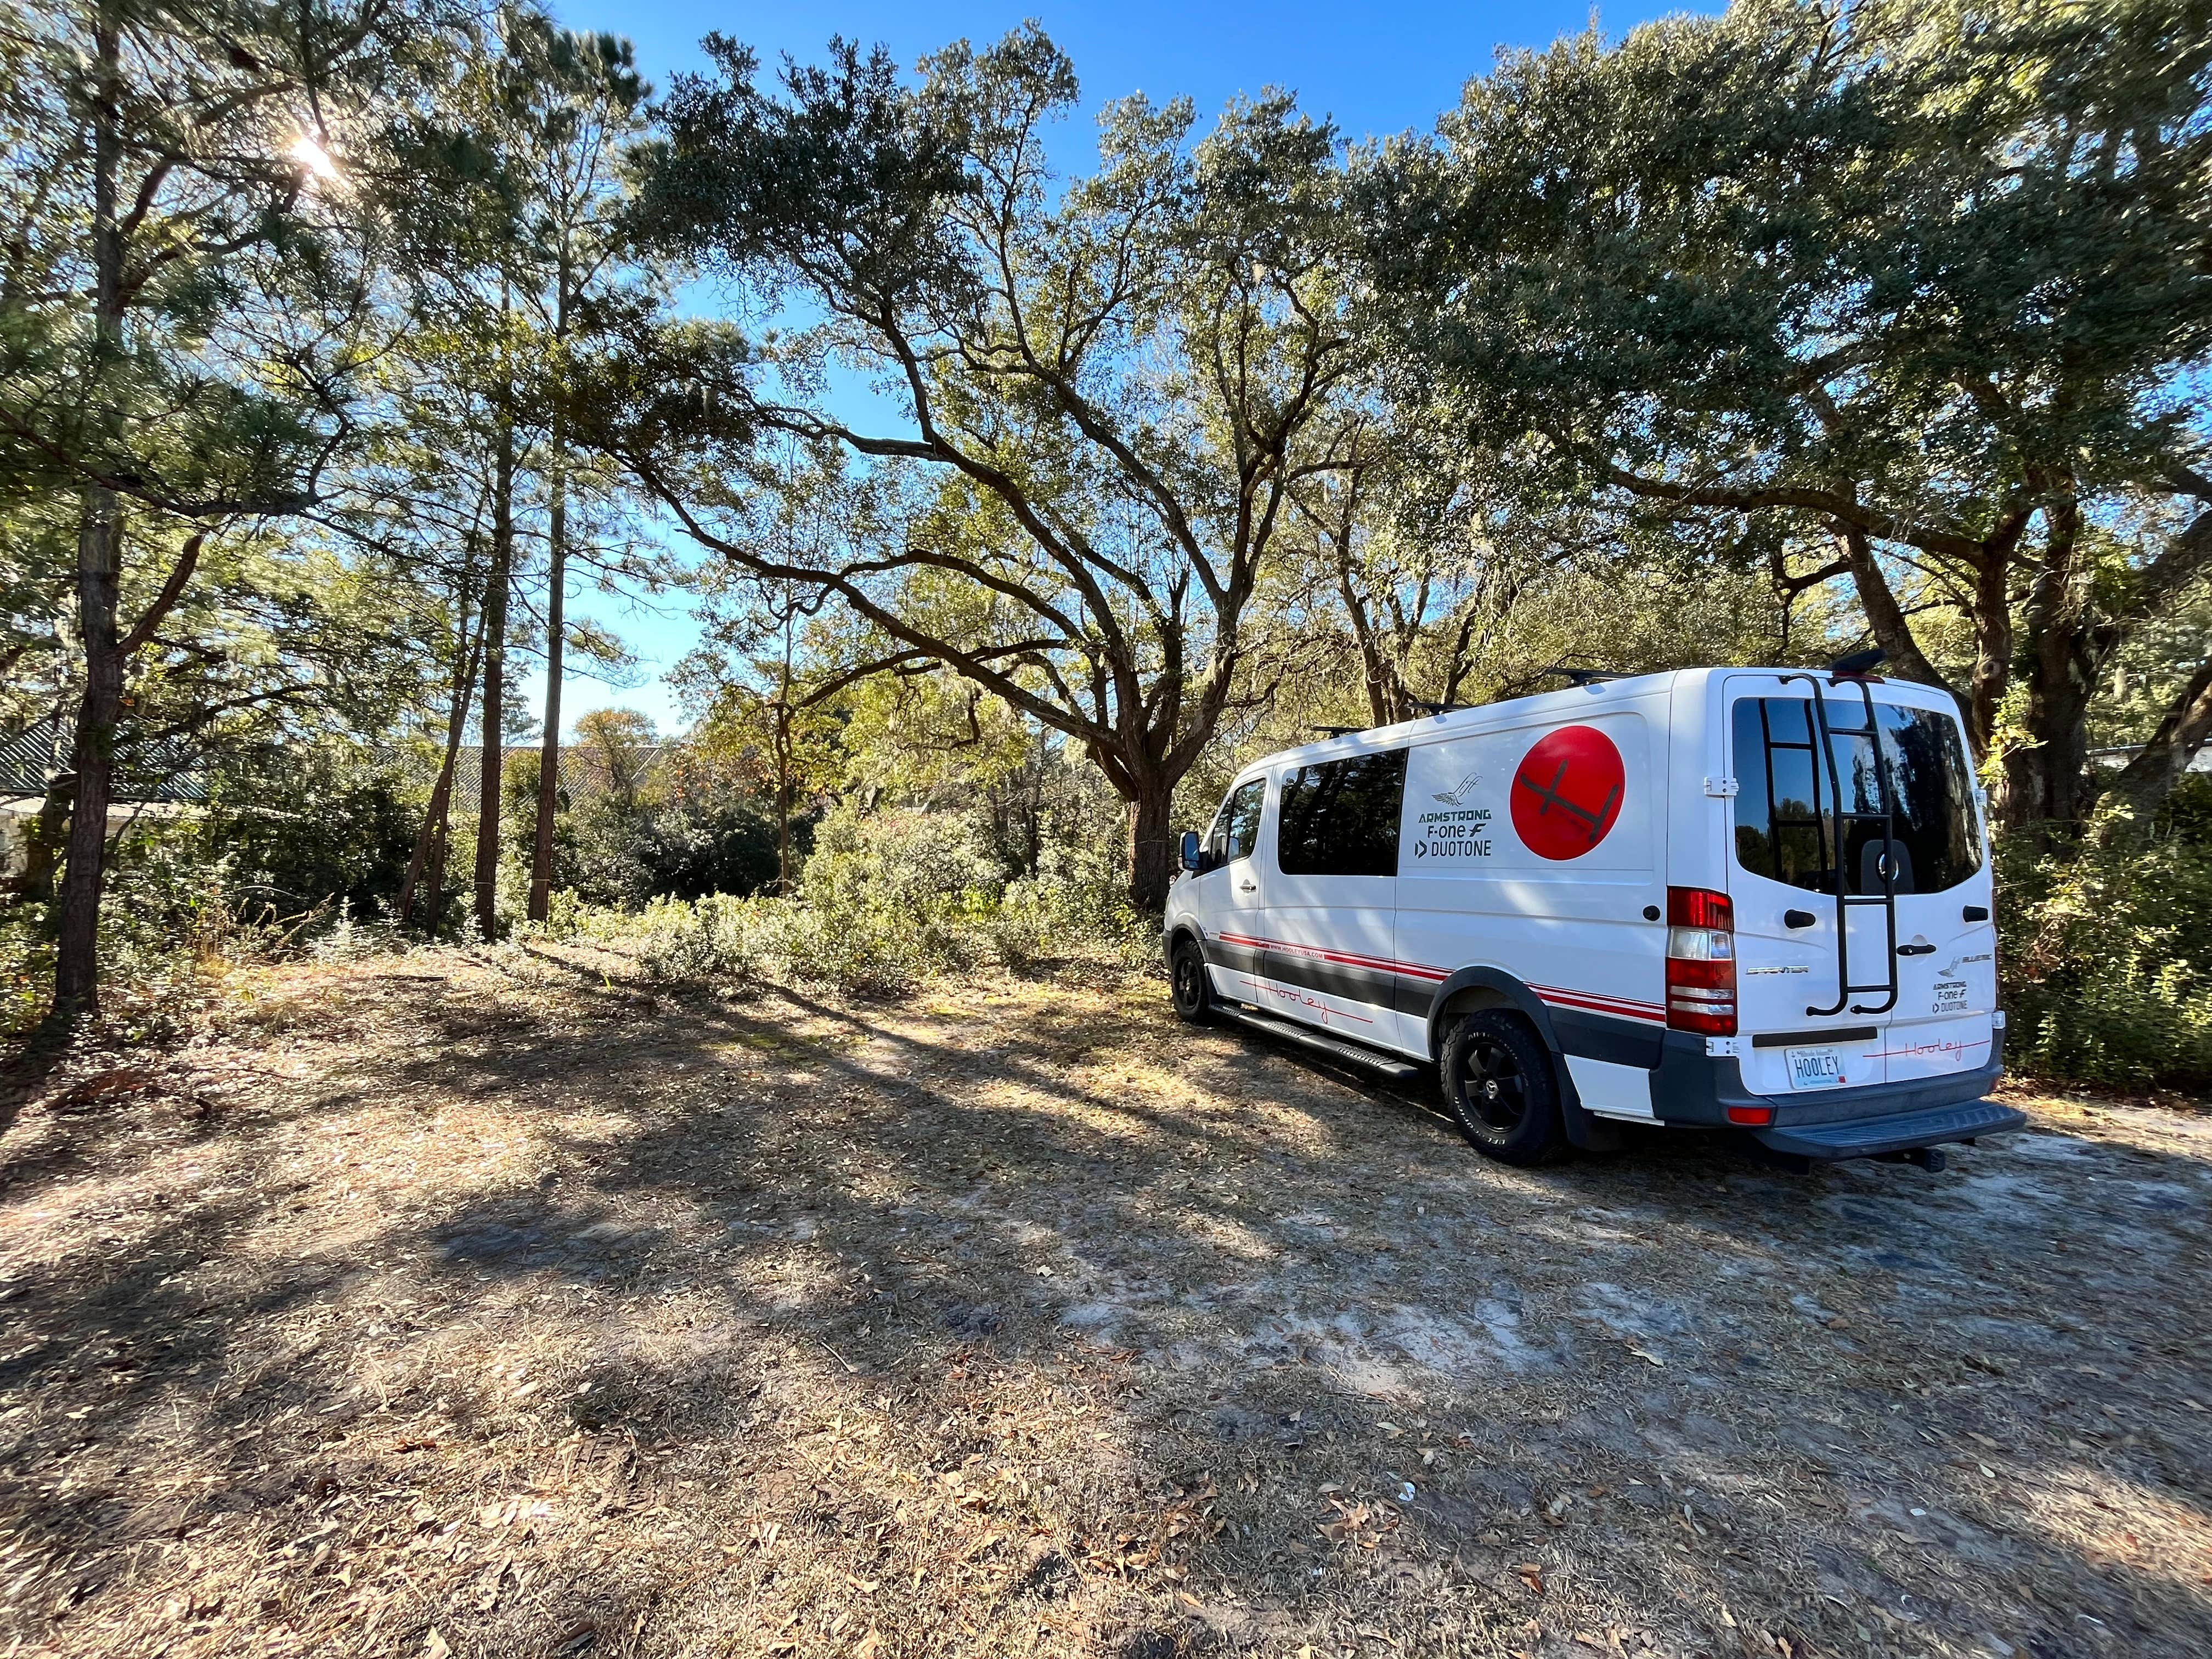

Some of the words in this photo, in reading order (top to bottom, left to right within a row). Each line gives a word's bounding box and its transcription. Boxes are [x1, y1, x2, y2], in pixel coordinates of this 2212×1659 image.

[1418, 809, 1492, 823] ARMSTRONG
[1431, 840, 1492, 856] DUOTONE
[1268, 980, 1329, 1025] Hooley
[1905, 1038, 1962, 1062] Hooley
[1794, 1056, 1839, 1079] HOOLEY
